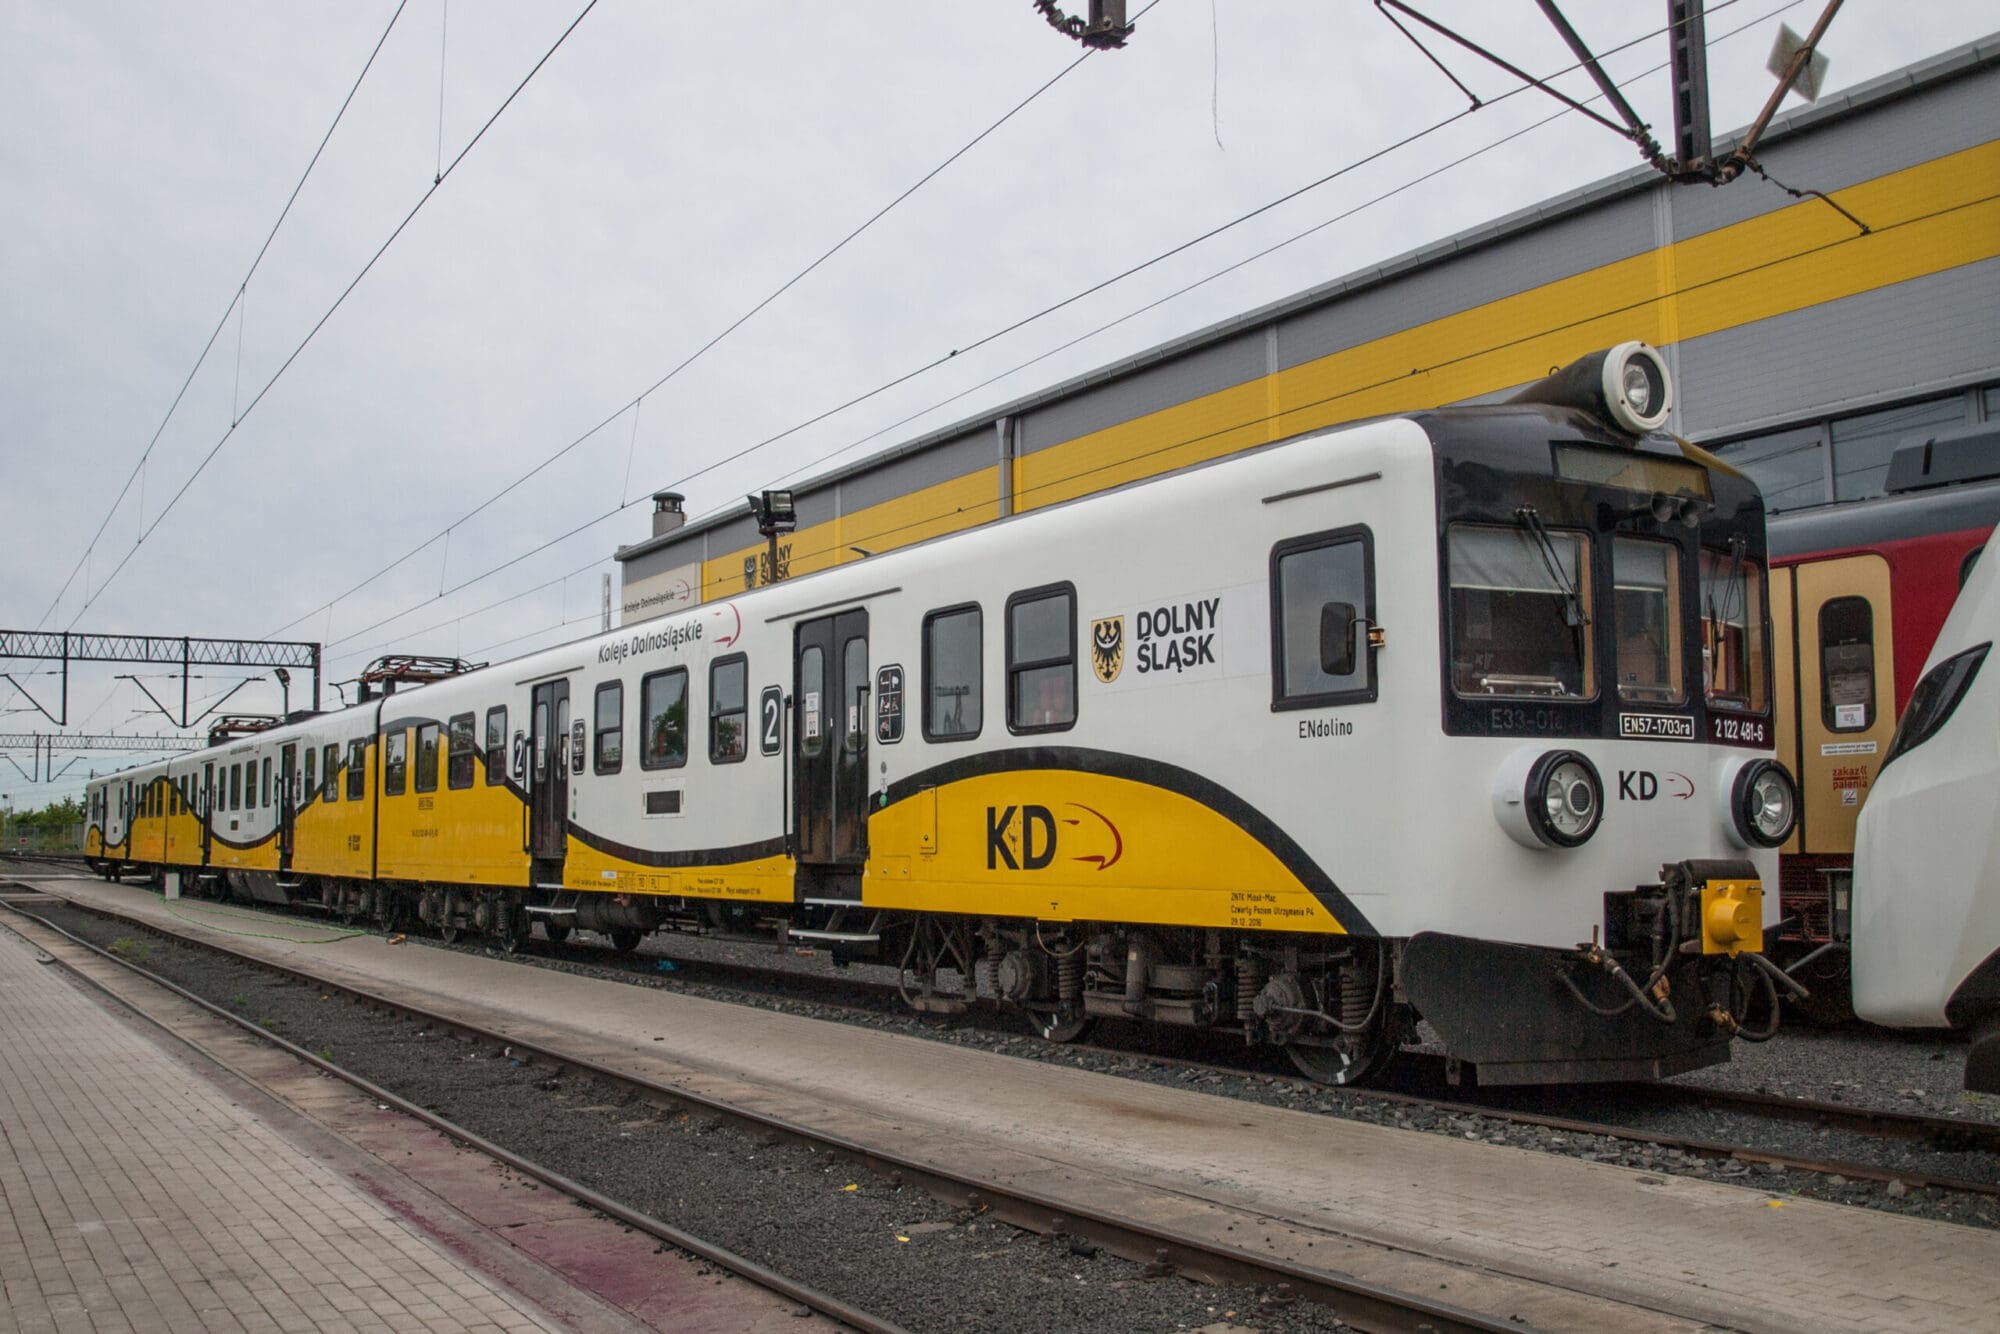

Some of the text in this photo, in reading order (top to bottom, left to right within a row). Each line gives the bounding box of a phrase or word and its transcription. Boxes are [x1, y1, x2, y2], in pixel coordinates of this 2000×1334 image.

[761, 543, 792, 567] DNY
[761, 561, 790, 585] ŚLSK
[1137, 598, 1220, 640] DOLNY
[598, 620, 703, 664] Koleje Dolnośląskie
[1136, 634, 1215, 673] ŚLĄSK
[765, 698, 778, 744] 2
[1299, 718, 1353, 739] ENdolino
[1623, 716, 1690, 737] EN57-1703ra
[1715, 719, 1763, 742] 2 122 481-6
[515, 740, 523, 773] 2
[1619, 770, 1658, 801] KD
[1832, 767, 1859, 777] zakaz
[1832, 780, 1868, 791] palenia
[987, 805, 1057, 870] KD
